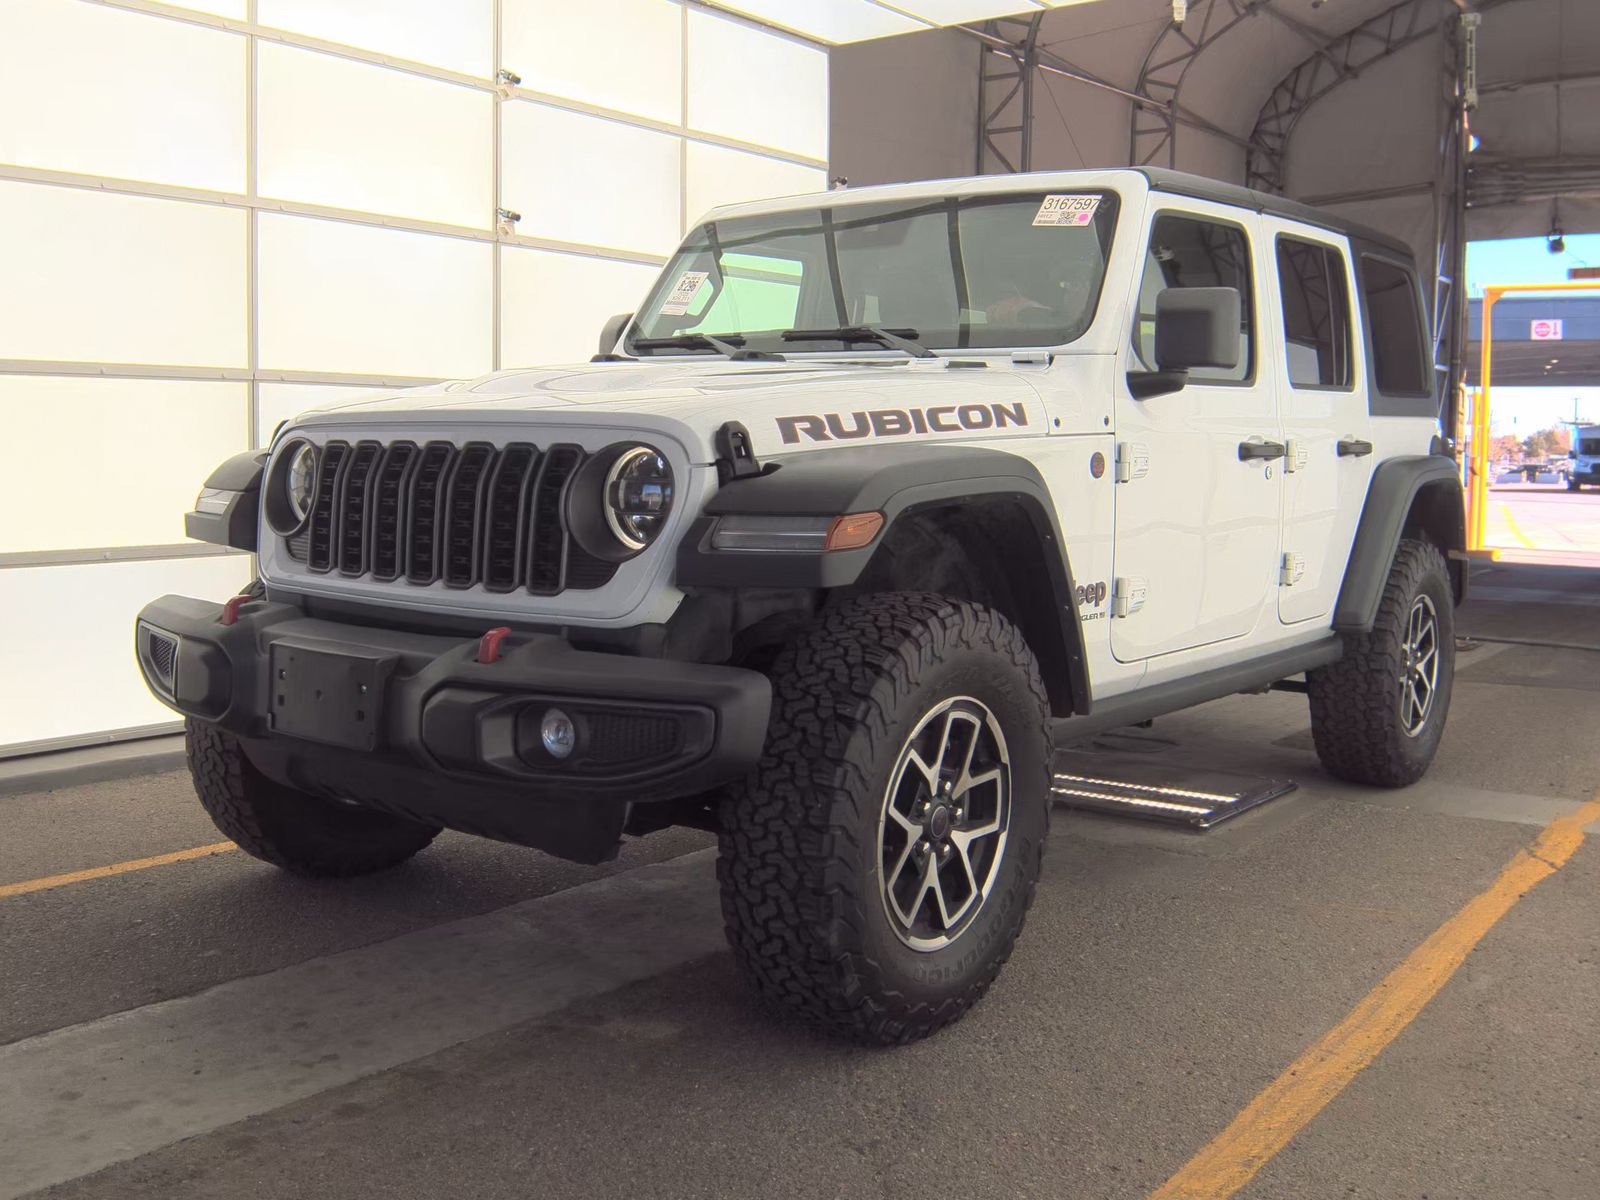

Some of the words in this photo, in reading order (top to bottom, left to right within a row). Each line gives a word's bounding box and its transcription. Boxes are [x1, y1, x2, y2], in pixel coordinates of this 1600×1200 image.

[1043, 198, 1101, 210] 3167597
[775, 402, 1028, 444] RUBICON
[1073, 580, 1106, 607] eep
